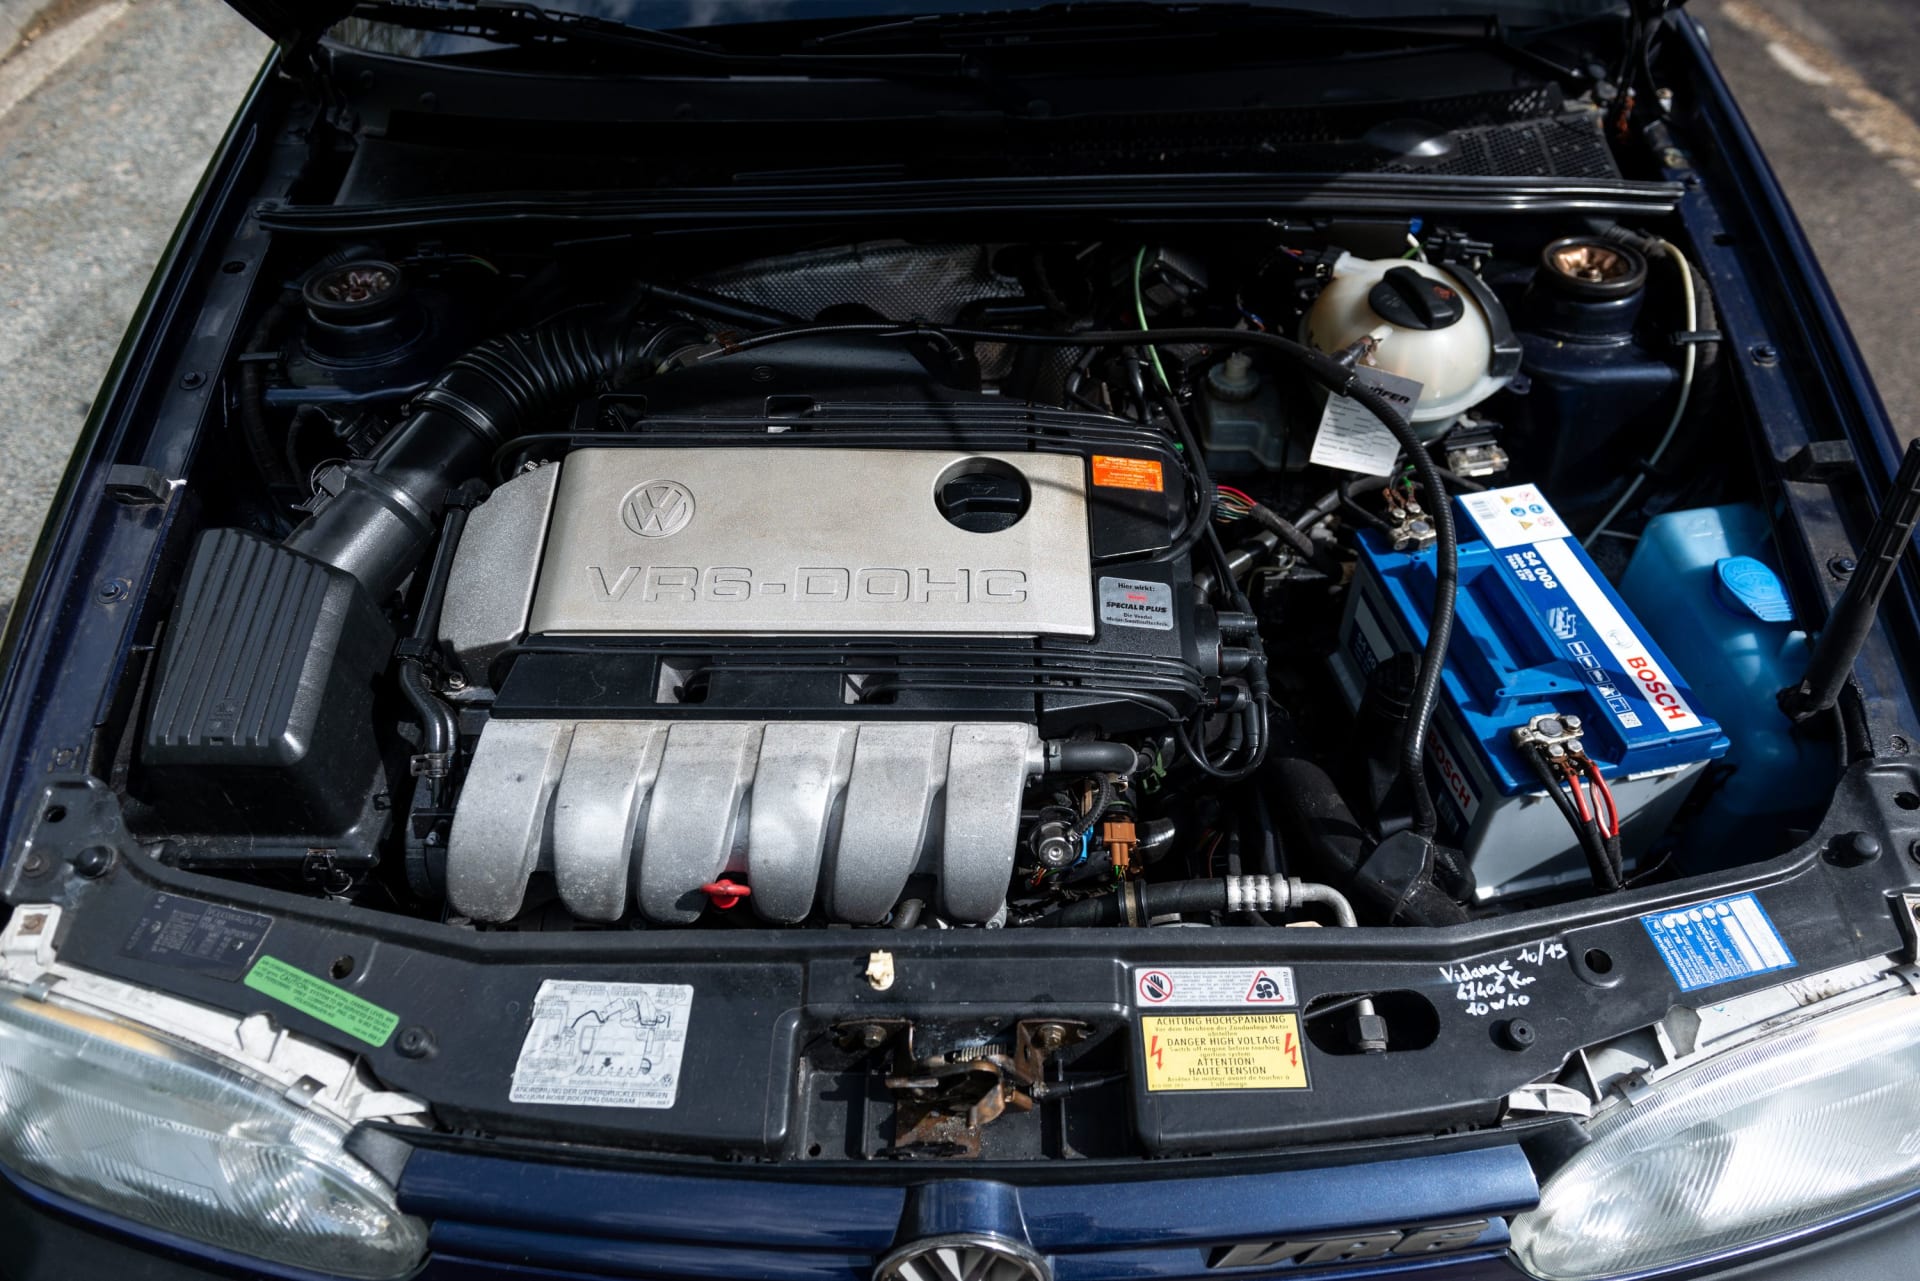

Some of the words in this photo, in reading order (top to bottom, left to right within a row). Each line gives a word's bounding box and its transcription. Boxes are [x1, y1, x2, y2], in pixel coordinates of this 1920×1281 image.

[620, 479, 696, 538] VW
[1522, 551, 1541, 566] S4
[1534, 567, 1557, 589] 008
[586, 565, 1028, 603] VR6-DOHC
[1117, 582, 1133, 590] Hier
[1106, 601, 1138, 611] SPECIAL
[1146, 604, 1168, 613] PLUS
[1627, 656, 1687, 720] BOSCH
[1427, 729, 1471, 809] BOSCH
[1156, 1017, 1202, 1026] ACHTUNG
[1205, 1015, 1286, 1025] HOCHSPANNUNG
[1167, 1037, 1207, 1047] DANGER
[1209, 1036, 1235, 1046] HIGH
[1237, 1035, 1281, 1045] VOLTAGE
[1188, 1067, 1221, 1076] HAUTE
[1223, 1066, 1267, 1075] TENSION
[1197, 1057, 1256, 1067] ATTENTION!
[1206, 1219, 1490, 1268] VR6
